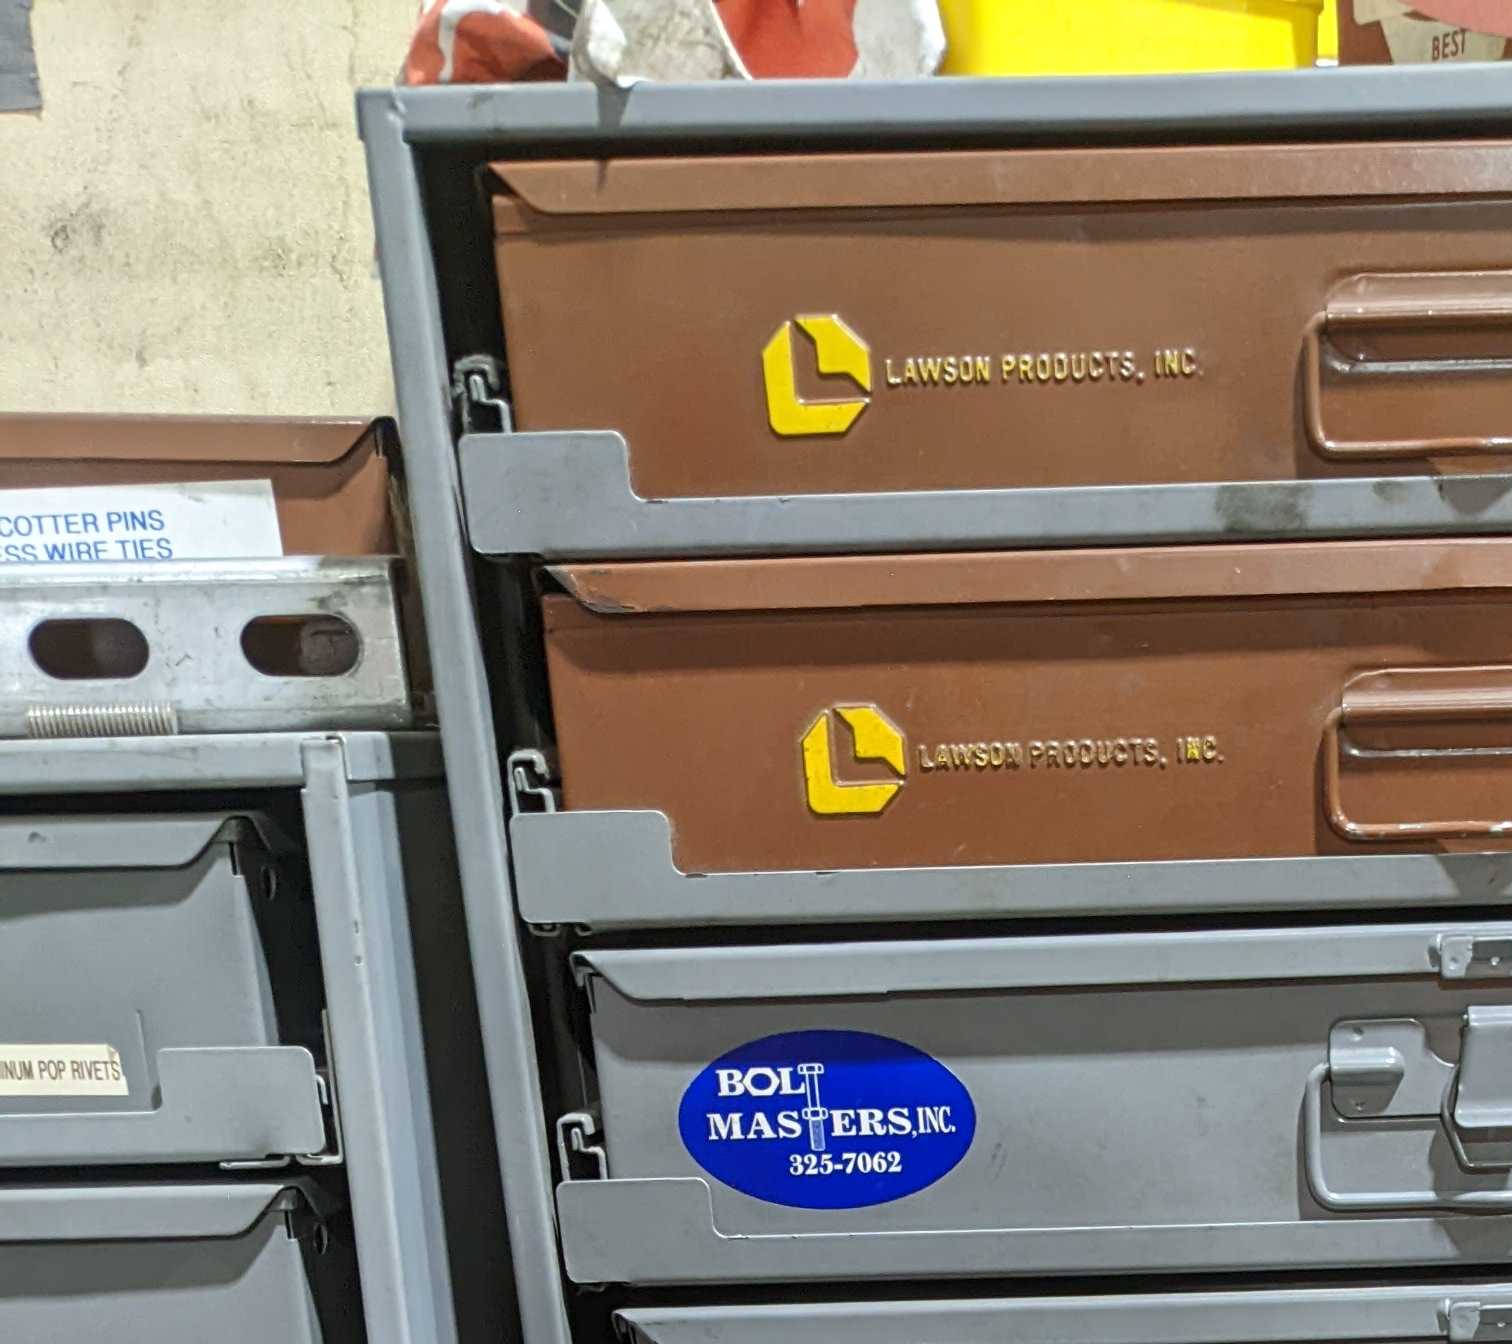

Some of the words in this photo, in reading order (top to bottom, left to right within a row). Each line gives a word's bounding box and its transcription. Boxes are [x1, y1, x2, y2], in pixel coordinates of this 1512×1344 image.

[1431, 29, 1467, 60] BEST
[884, 355, 991, 386] LAWSON
[1001, 350, 1145, 385] PRODUCTS,
[1154, 348, 1204, 378] INC.
[0, 512, 99, 537] COTTER
[107, 509, 165, 532] PINS
[118, 538, 173, 560] TIES
[917, 742, 1020, 773] LAWSON
[1029, 737, 1168, 770] PRODUCTS,
[1176, 735, 1225, 765] INC.
[38, 1060, 66, 1080] POP
[71, 1060, 121, 1081] RIVETS
[789, 1151, 902, 1175] 325-7062
